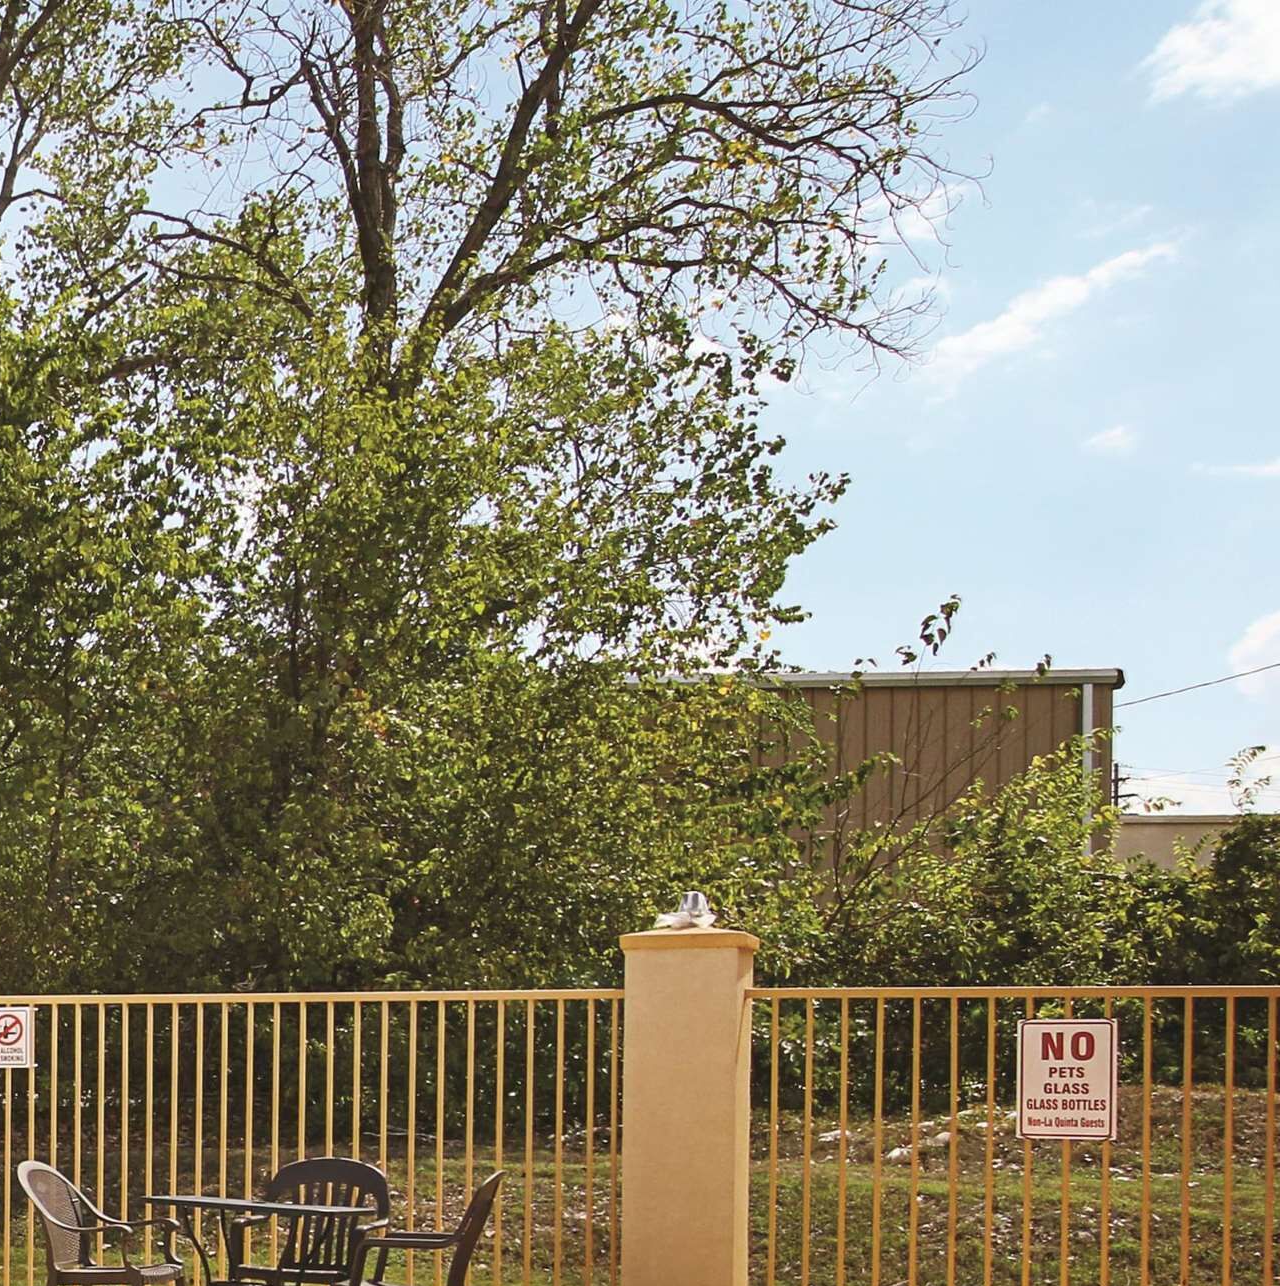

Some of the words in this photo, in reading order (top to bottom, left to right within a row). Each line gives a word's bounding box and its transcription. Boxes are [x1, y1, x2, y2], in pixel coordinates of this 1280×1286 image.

[1041, 1031, 1095, 1061] NO
[1048, 1067, 1085, 1078] PETS
[1043, 1083, 1090, 1095] GLASS
[1026, 1098, 1058, 1110] GLASS
[1061, 1099, 1106, 1111] BOTTLES
[1027, 1116, 1053, 1127] Non-La
[1054, 1117, 1078, 1128] Quinta
[1080, 1118, 1105, 1128] Guests
